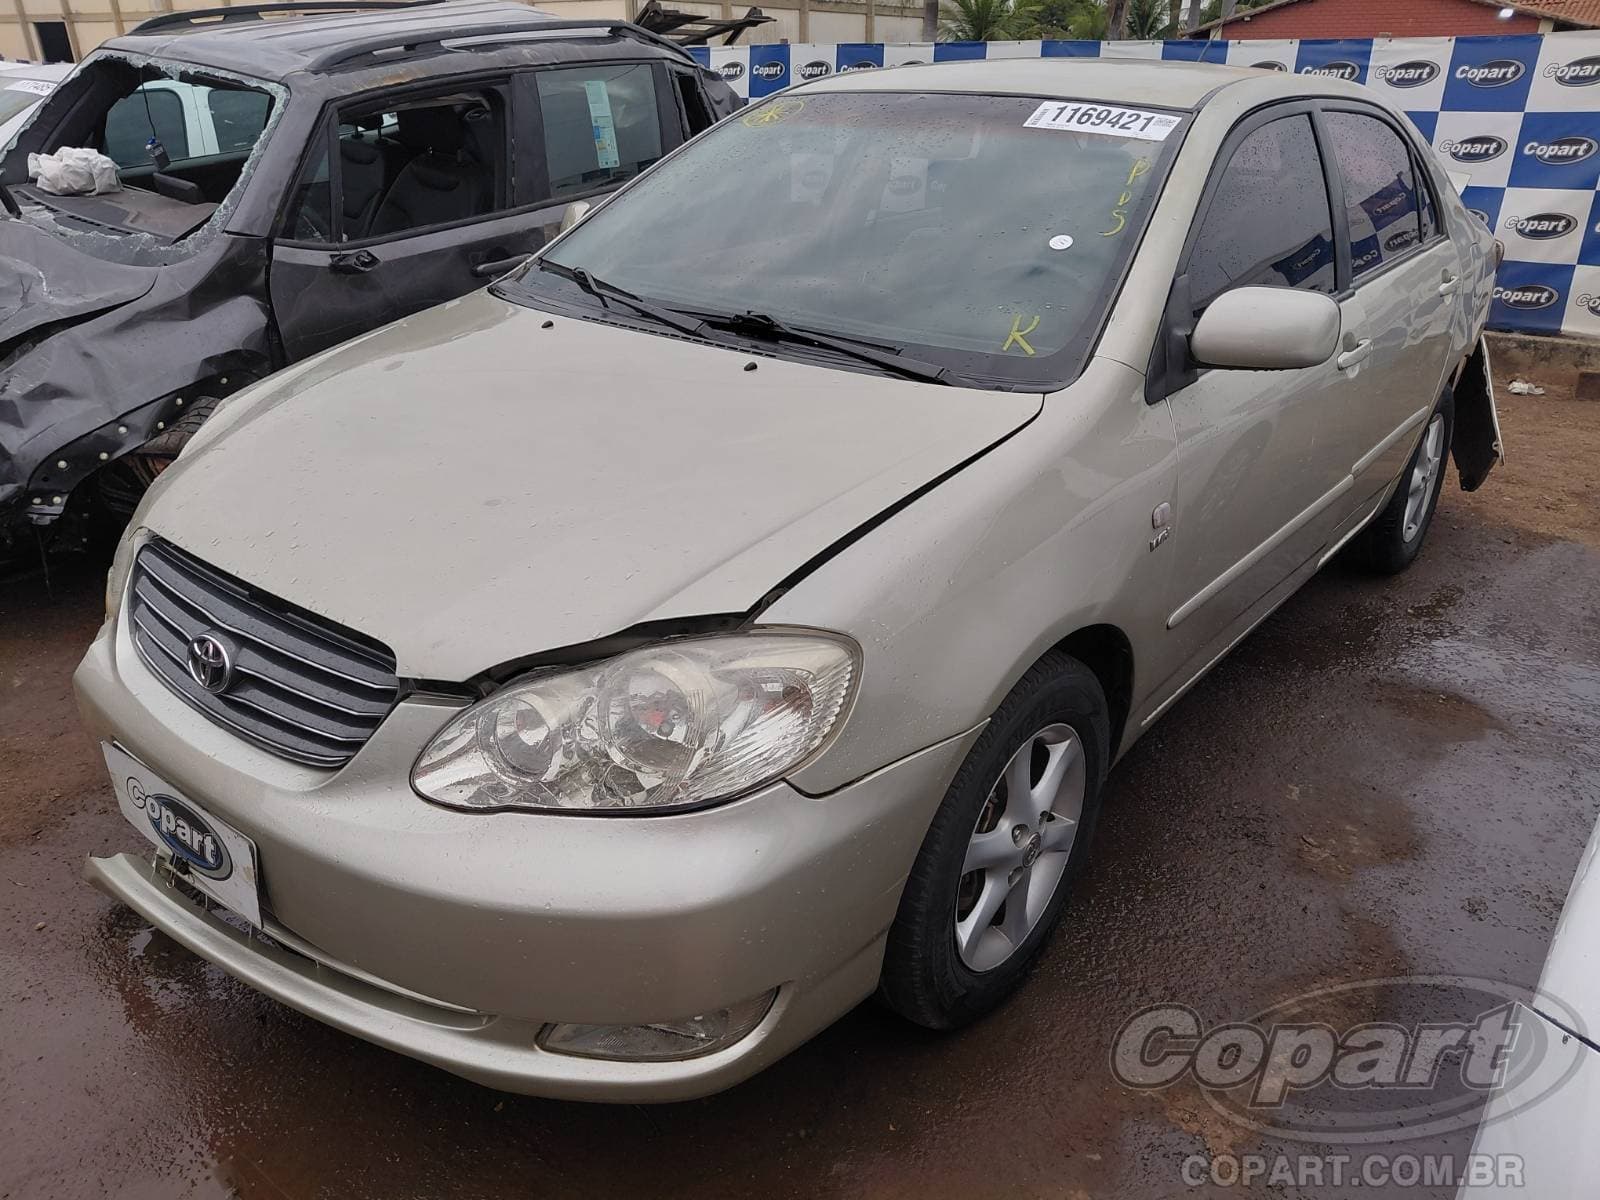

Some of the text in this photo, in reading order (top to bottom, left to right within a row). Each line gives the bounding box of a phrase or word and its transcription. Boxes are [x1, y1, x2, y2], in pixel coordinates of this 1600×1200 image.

[752, 64, 781, 77] Copart
[794, 63, 826, 77] Copart
[1301, 66, 1353, 79] Copart
[1375, 64, 1431, 80] Copart
[1455, 64, 1517, 82] Copart
[1051, 104, 1155, 132] 1169421
[1439, 139, 1498, 156] Copart
[1523, 142, 1589, 158] Copart
[1504, 216, 1567, 232] Copart
[1493, 287, 1549, 303] Copart
[126, 776, 218, 866] Copart
